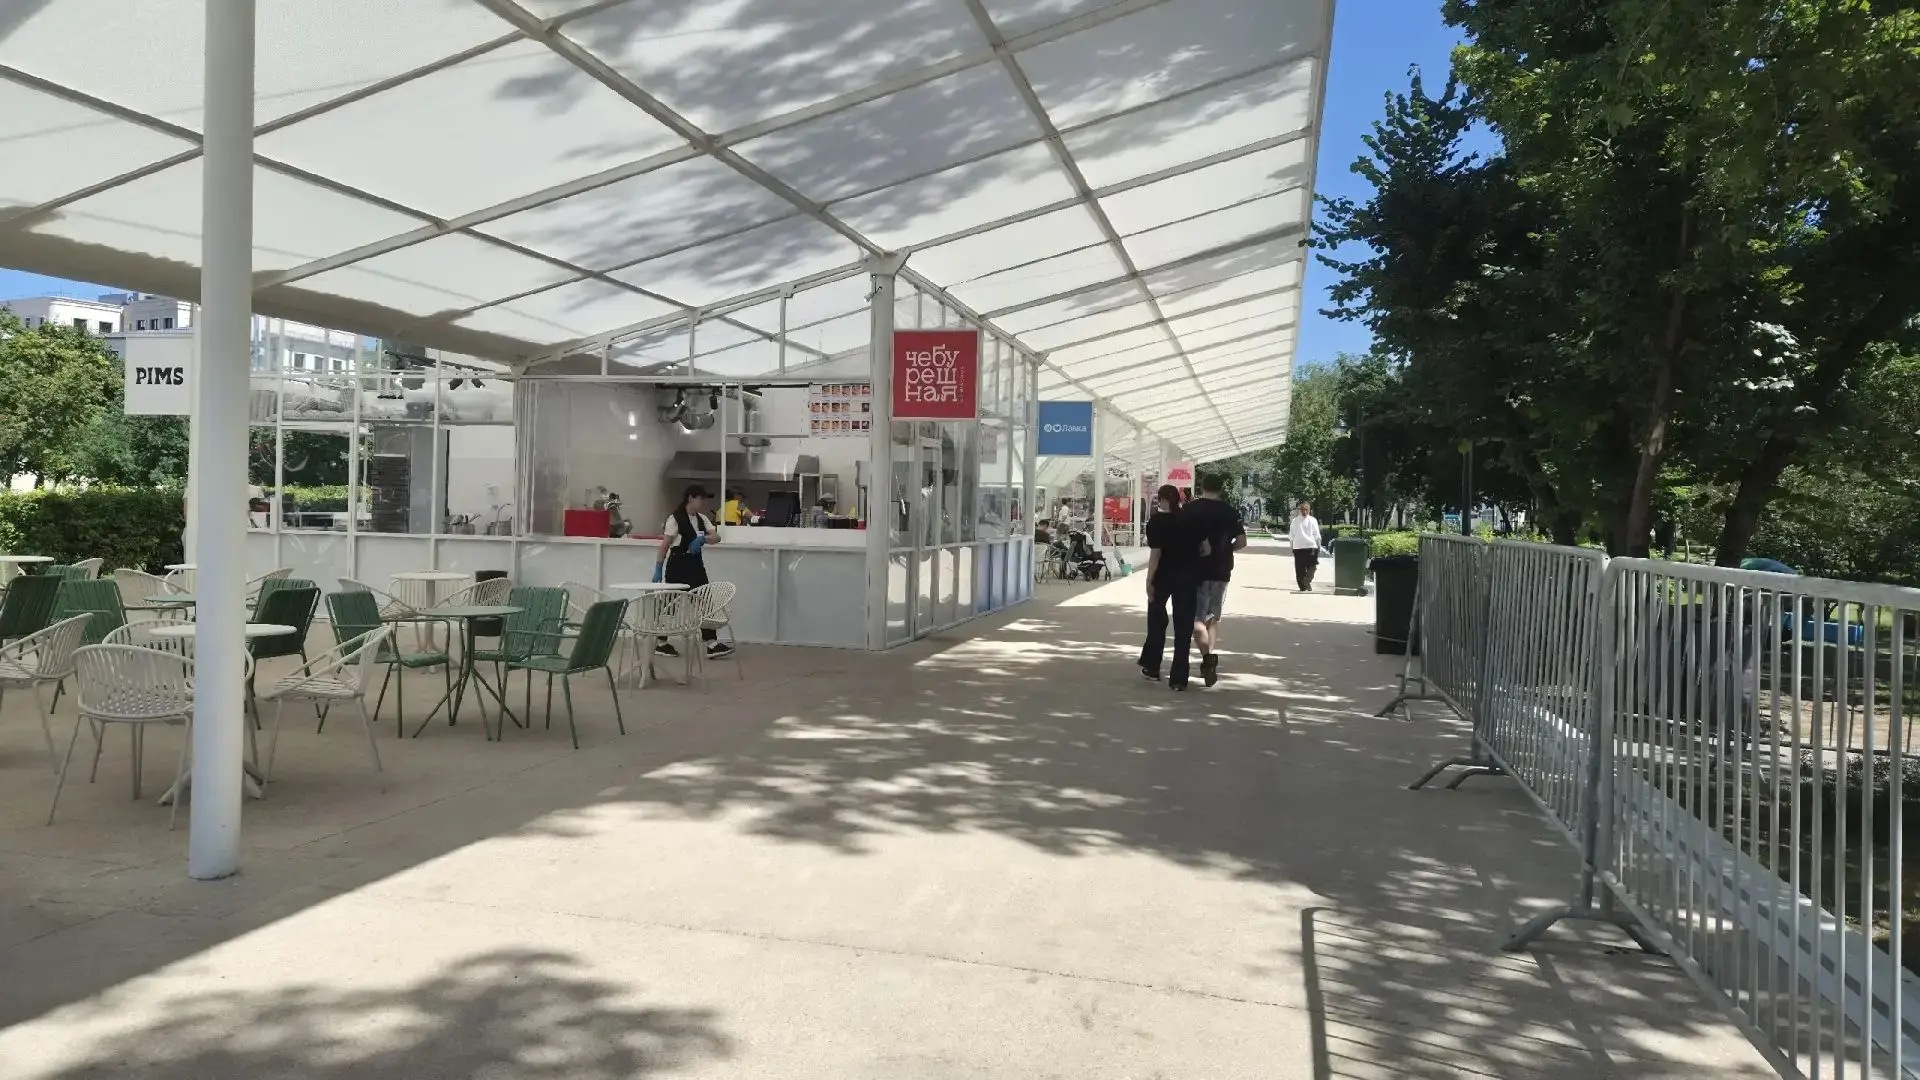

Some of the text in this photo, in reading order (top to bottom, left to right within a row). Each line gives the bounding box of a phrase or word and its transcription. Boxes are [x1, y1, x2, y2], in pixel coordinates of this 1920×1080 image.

[905, 343, 960, 368] чебу
[135, 367, 184, 385] PIMS
[905, 367, 957, 388] реш
[904, 384, 958, 402] ная
[1061, 424, 1087, 432] Лавка
